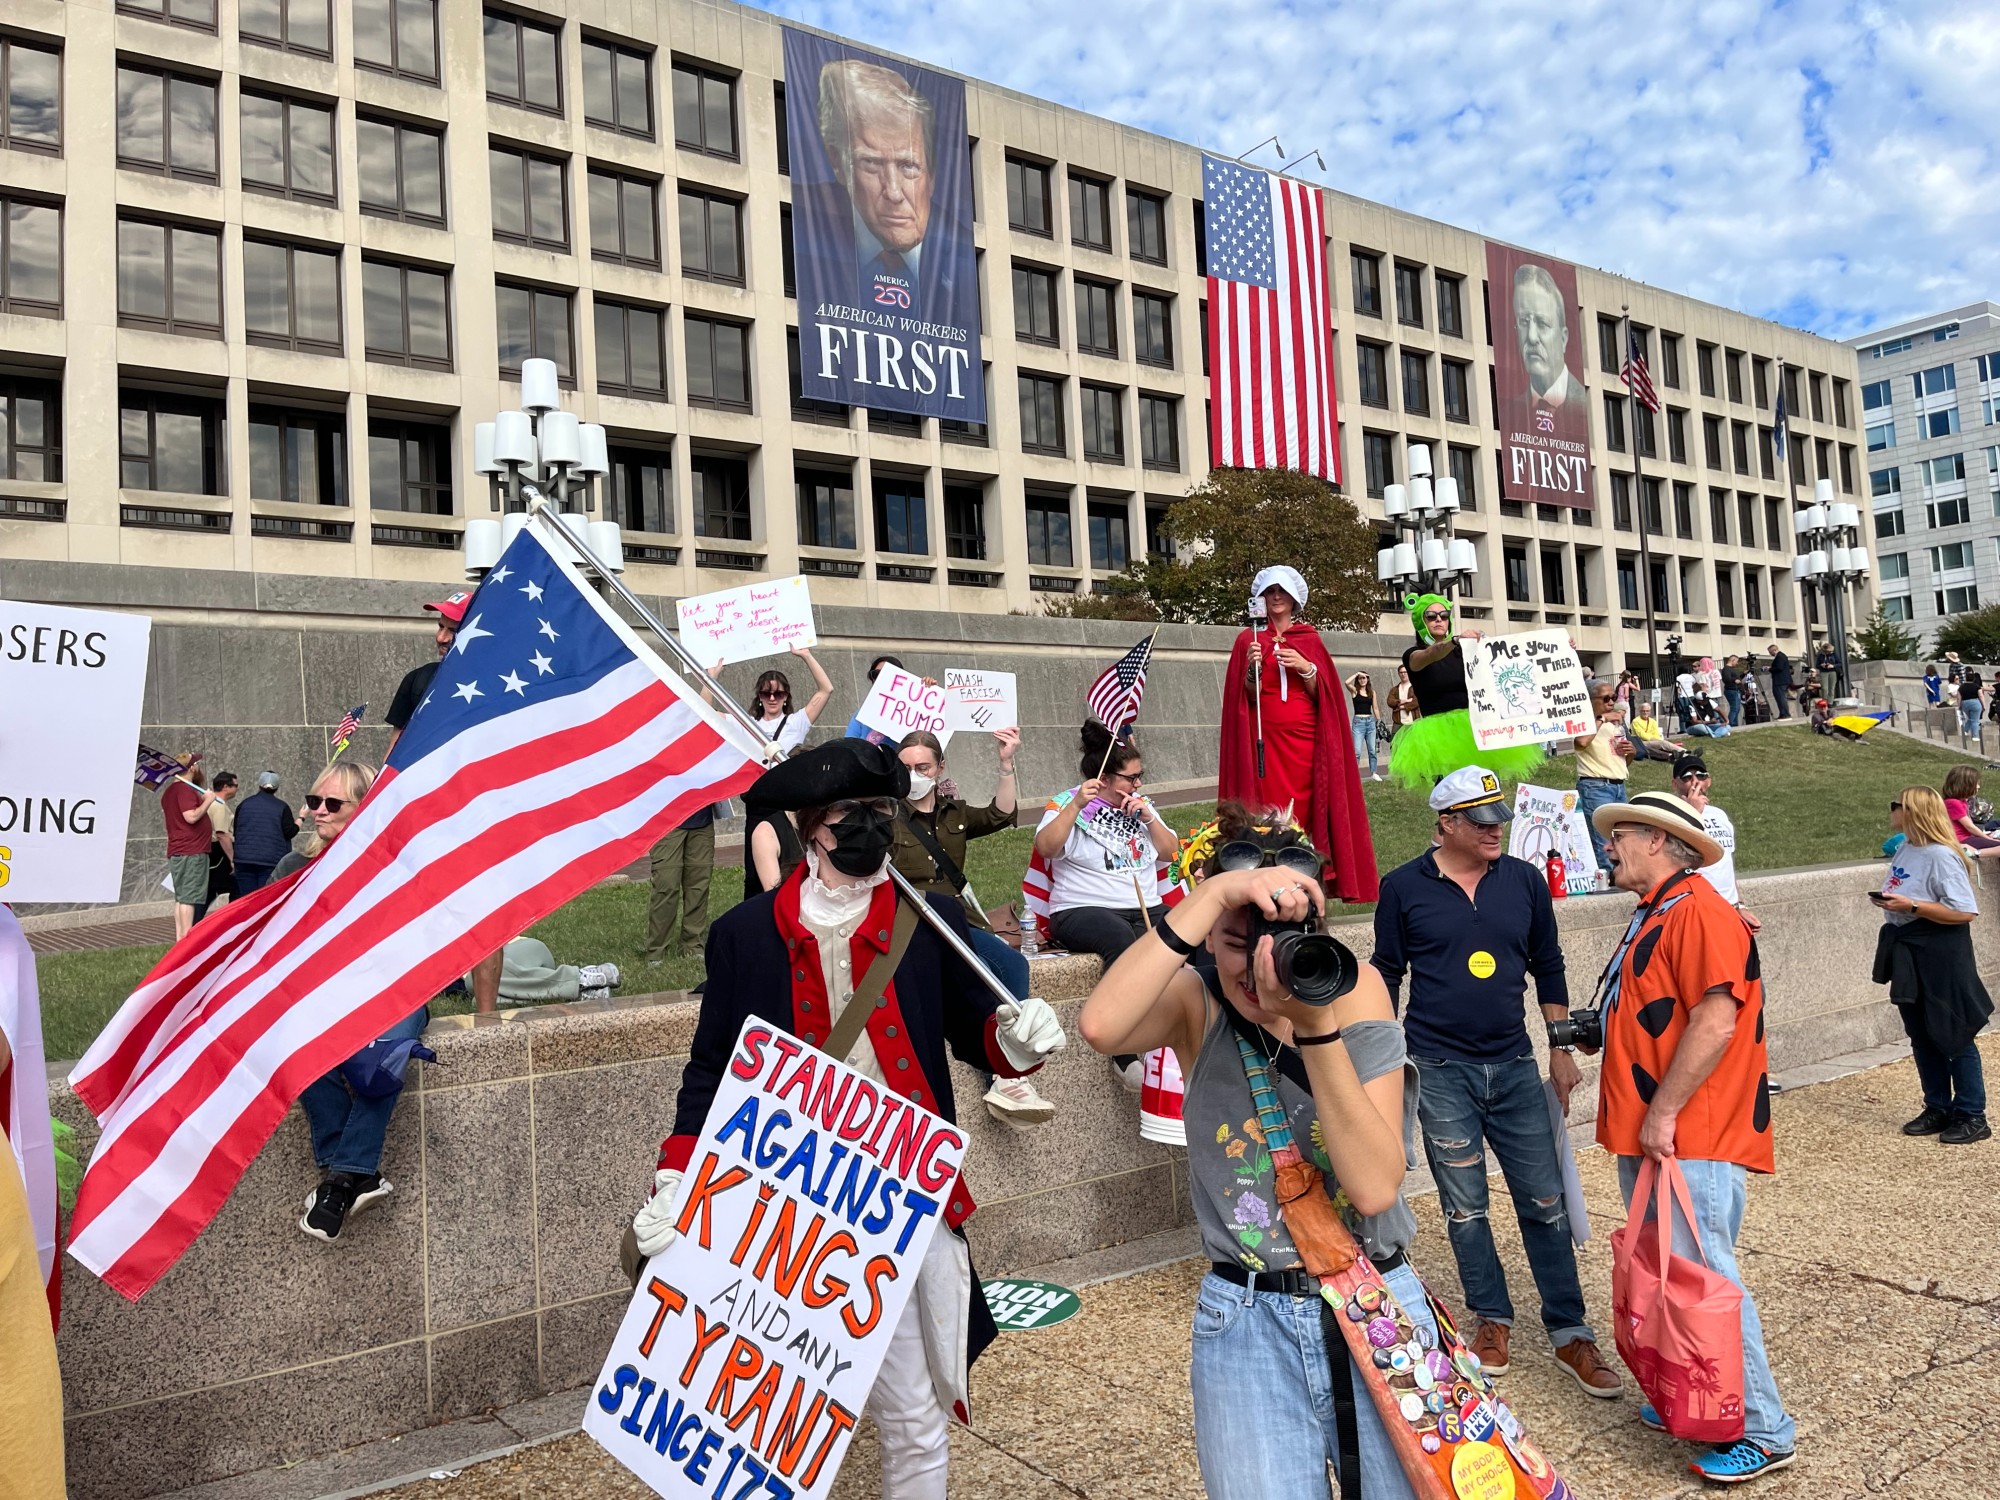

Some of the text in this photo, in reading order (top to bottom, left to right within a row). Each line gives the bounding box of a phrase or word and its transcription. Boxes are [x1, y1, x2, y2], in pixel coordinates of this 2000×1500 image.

[873, 273, 910, 288] AMERICA
[873, 284, 912, 309] 250
[814, 302, 967, 342] AMERICAN WORKERS
[814, 322, 970, 400] FIRST
[1509, 432, 1585, 453] AMERICAN WORKERS
[1509, 445, 1587, 494] FIRST
[682, 588, 780, 618] let your heart
[694, 605, 776, 630] break so your
[0, 624, 107, 668] SERS
[708, 624, 735, 641] spirit
[771, 630, 803, 646] gibson
[1484, 640, 1521, 665] Me
[946, 672, 983, 688] SMASH
[959, 687, 1004, 700] FASCISM
[878, 691, 945, 732] TRUMP
[1565, 719, 1587, 735] FREE
[1530, 797, 1557, 814] PEACE
[731, 1025, 964, 1194] STANDING
[714, 1095, 939, 1256] AGAINST
[1236, 1177, 1255, 1187] POPPY
[986, 1297, 1051, 1328] ER
[710, 1278, 853, 1386] AND ANY
[638, 1276, 860, 1492] TYRANT
[598, 1363, 724, 1487] SINCE
[1468, 1404, 1486, 1424] LIKE
[1469, 1411, 1492, 1438] IKE
[1458, 1449, 1497, 1480] MY BODY
[1461, 1460, 1509, 1496] MY CHOICE
[1482, 1482, 1503, 1500] 2024
